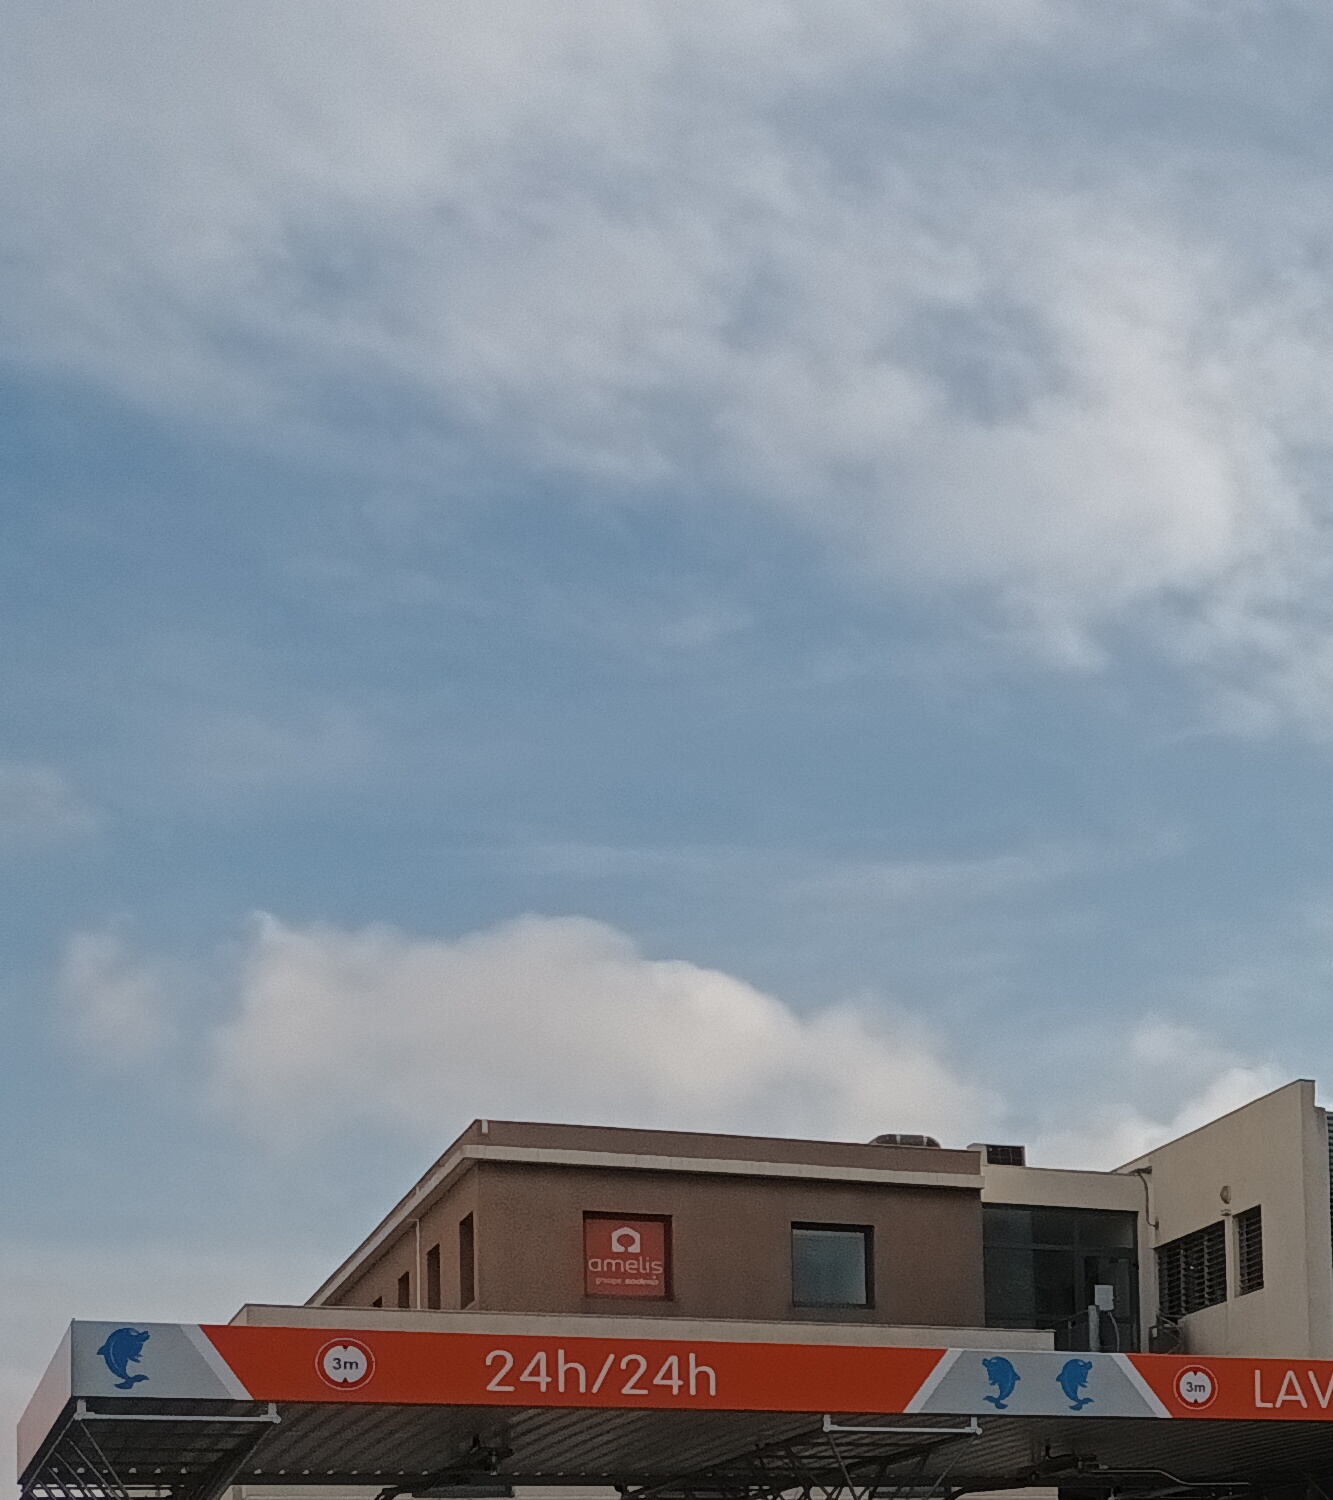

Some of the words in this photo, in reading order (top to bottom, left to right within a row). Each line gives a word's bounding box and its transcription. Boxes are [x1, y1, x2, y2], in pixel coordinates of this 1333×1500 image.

[588, 1255, 663, 1274] amelis
[330, 1355, 360, 1372] 3m
[485, 1348, 718, 1396] 24h/24h
[1185, 1380, 1207, 1394] 3m
